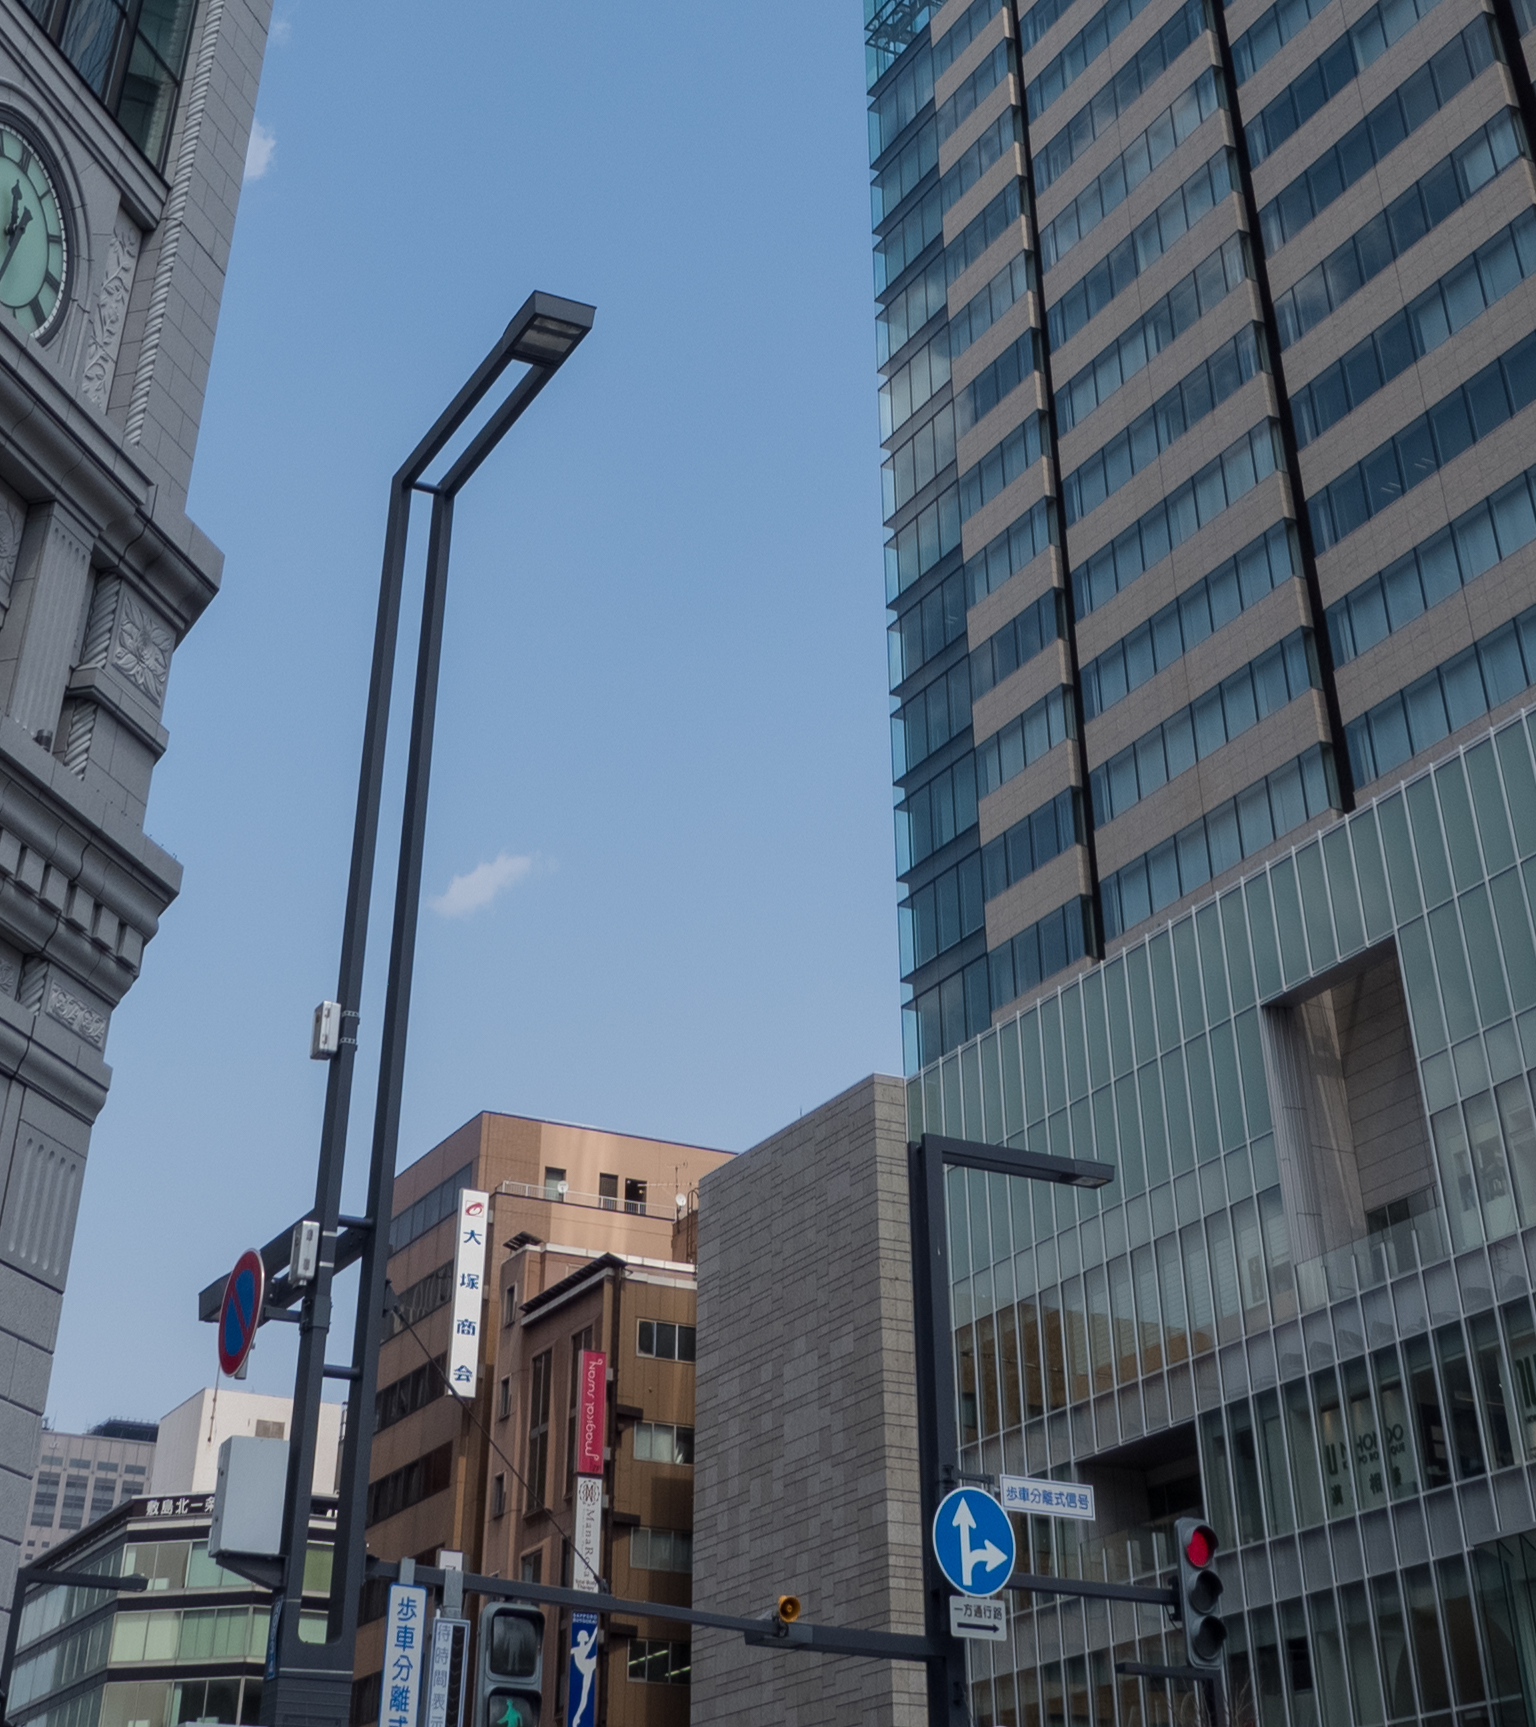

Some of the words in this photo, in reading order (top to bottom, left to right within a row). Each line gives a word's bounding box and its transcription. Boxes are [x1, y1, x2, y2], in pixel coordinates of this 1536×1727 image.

[453, 1229, 482, 1383] 大塚商会
[585, 1401, 600, 1461] magical
[1006, 1485, 1089, 1511] 歩車分離式信号
[953, 1603, 1003, 1621] 一方通行路
[431, 1624, 450, 1727] 待時間表示
